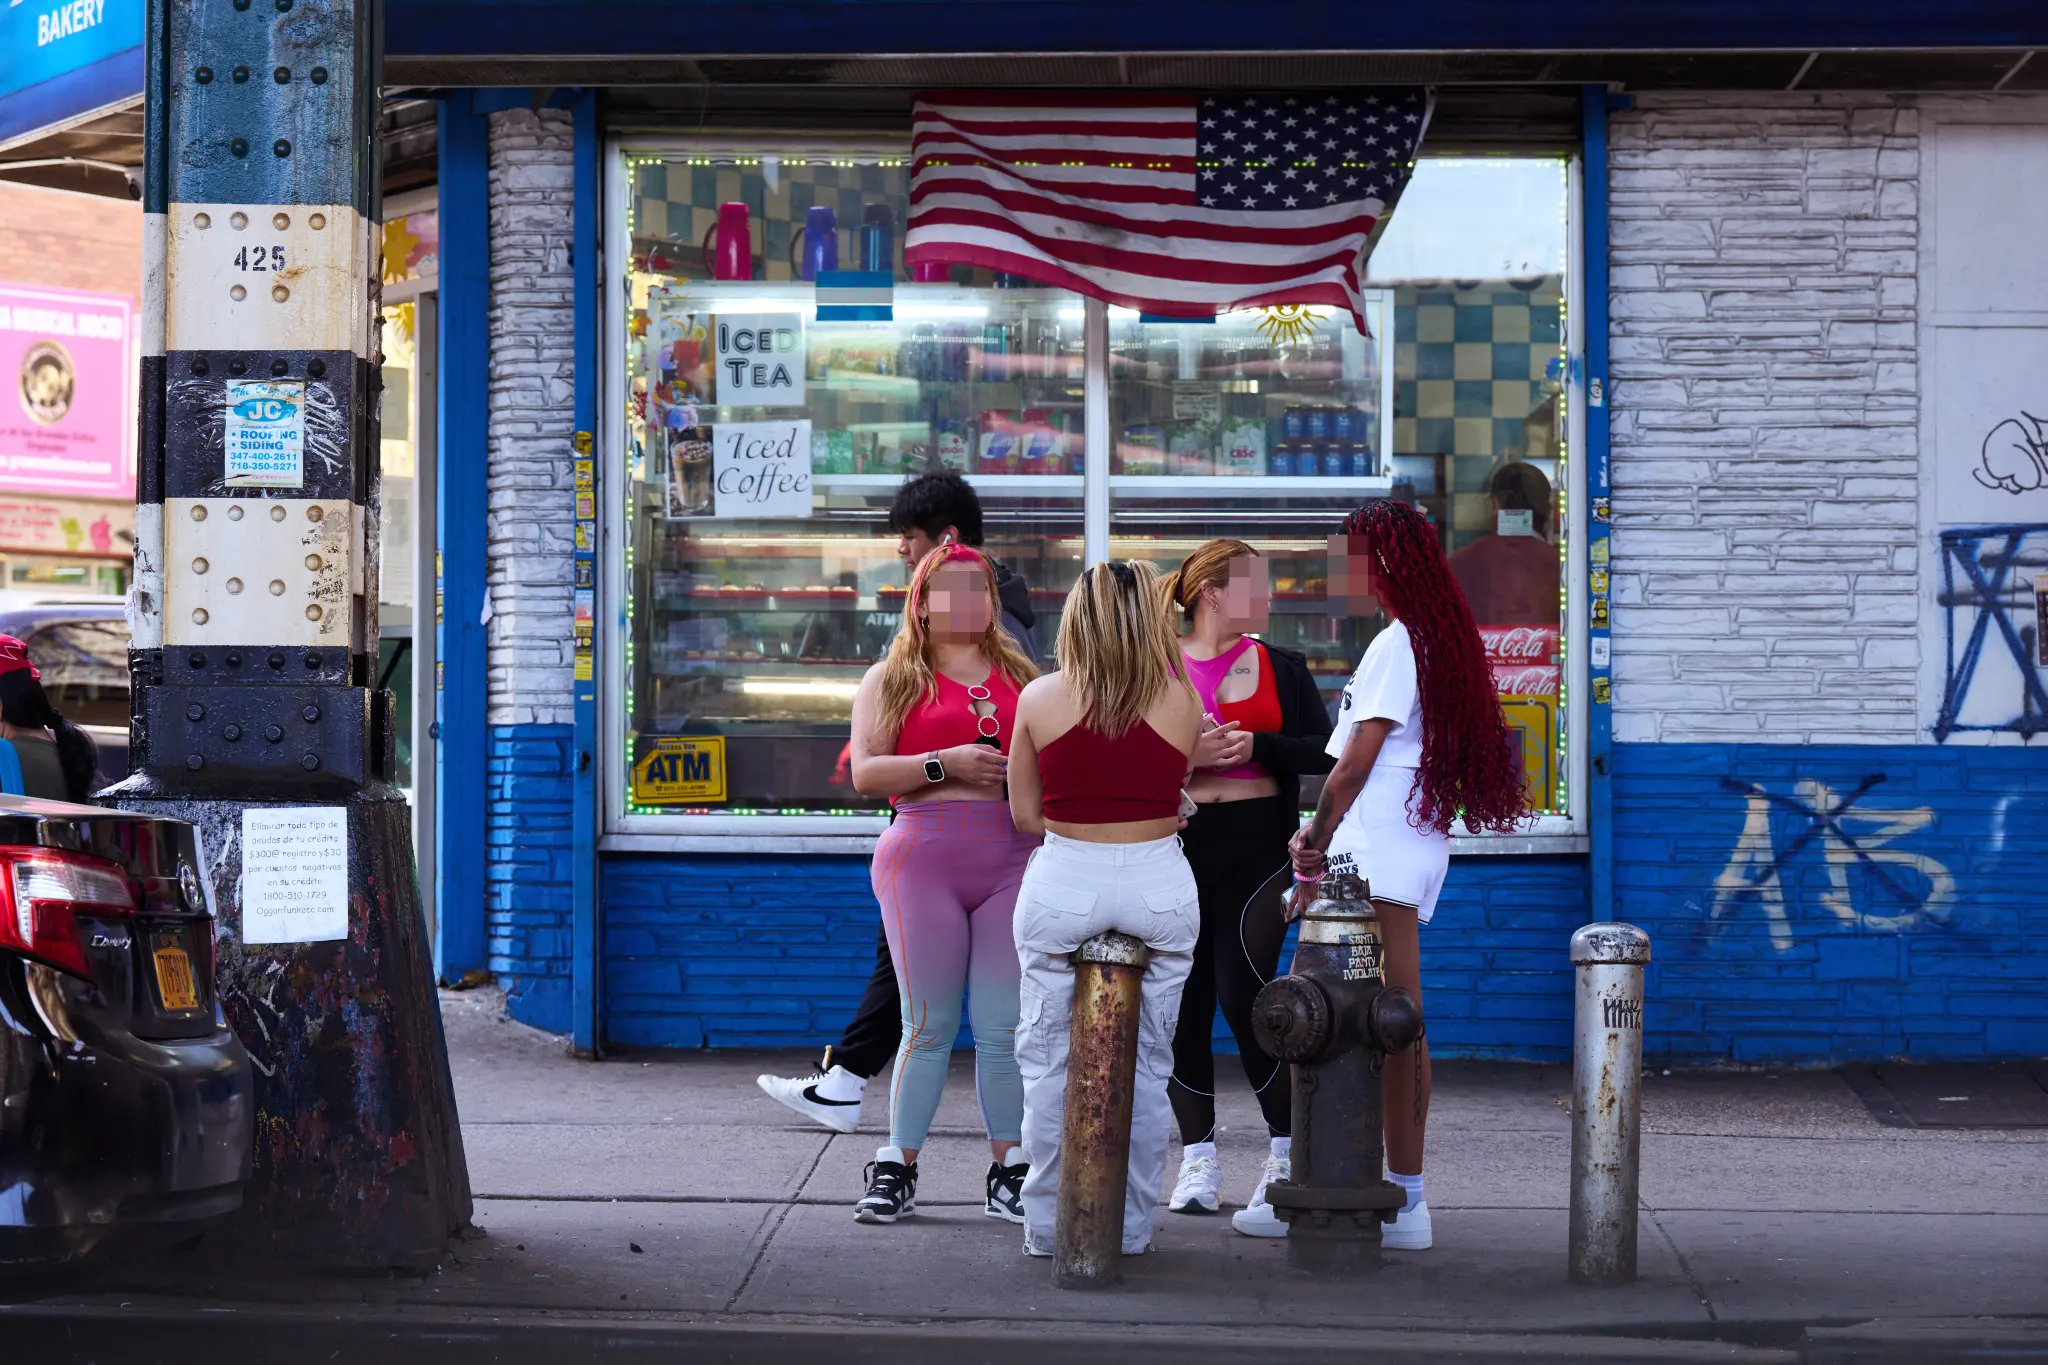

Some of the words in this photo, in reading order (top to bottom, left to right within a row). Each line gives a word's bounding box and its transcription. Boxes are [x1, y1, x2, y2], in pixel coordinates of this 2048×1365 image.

[37, 0, 104, 47] BAKERY
[233, 245, 285, 271] 425
[718, 323, 797, 354] ICED
[725, 358, 792, 388] TEA
[248, 401, 282, 420] JC
[240, 430, 298, 440] ROOFNG
[240, 440, 284, 450] SIDING
[727, 427, 798, 460] Iced
[230, 452, 297, 461] 347-400-2611
[230, 461, 297, 471] 718-350-5271
[717, 462, 809, 503] Coffee
[646, 752, 711, 782] ATM
[288, 821, 307, 829] todo
[309, 821, 326, 830] tipo
[251, 836, 281, 844] deudas
[307, 834, 338, 843] crédito
[282, 849, 317, 859] registro
[248, 866, 262, 874] por
[265, 864, 297, 872] cuentas
[302, 864, 342, 873] negativas
[291, 877, 323, 886] crédito
[1348, 956, 1376, 968] PANTY
